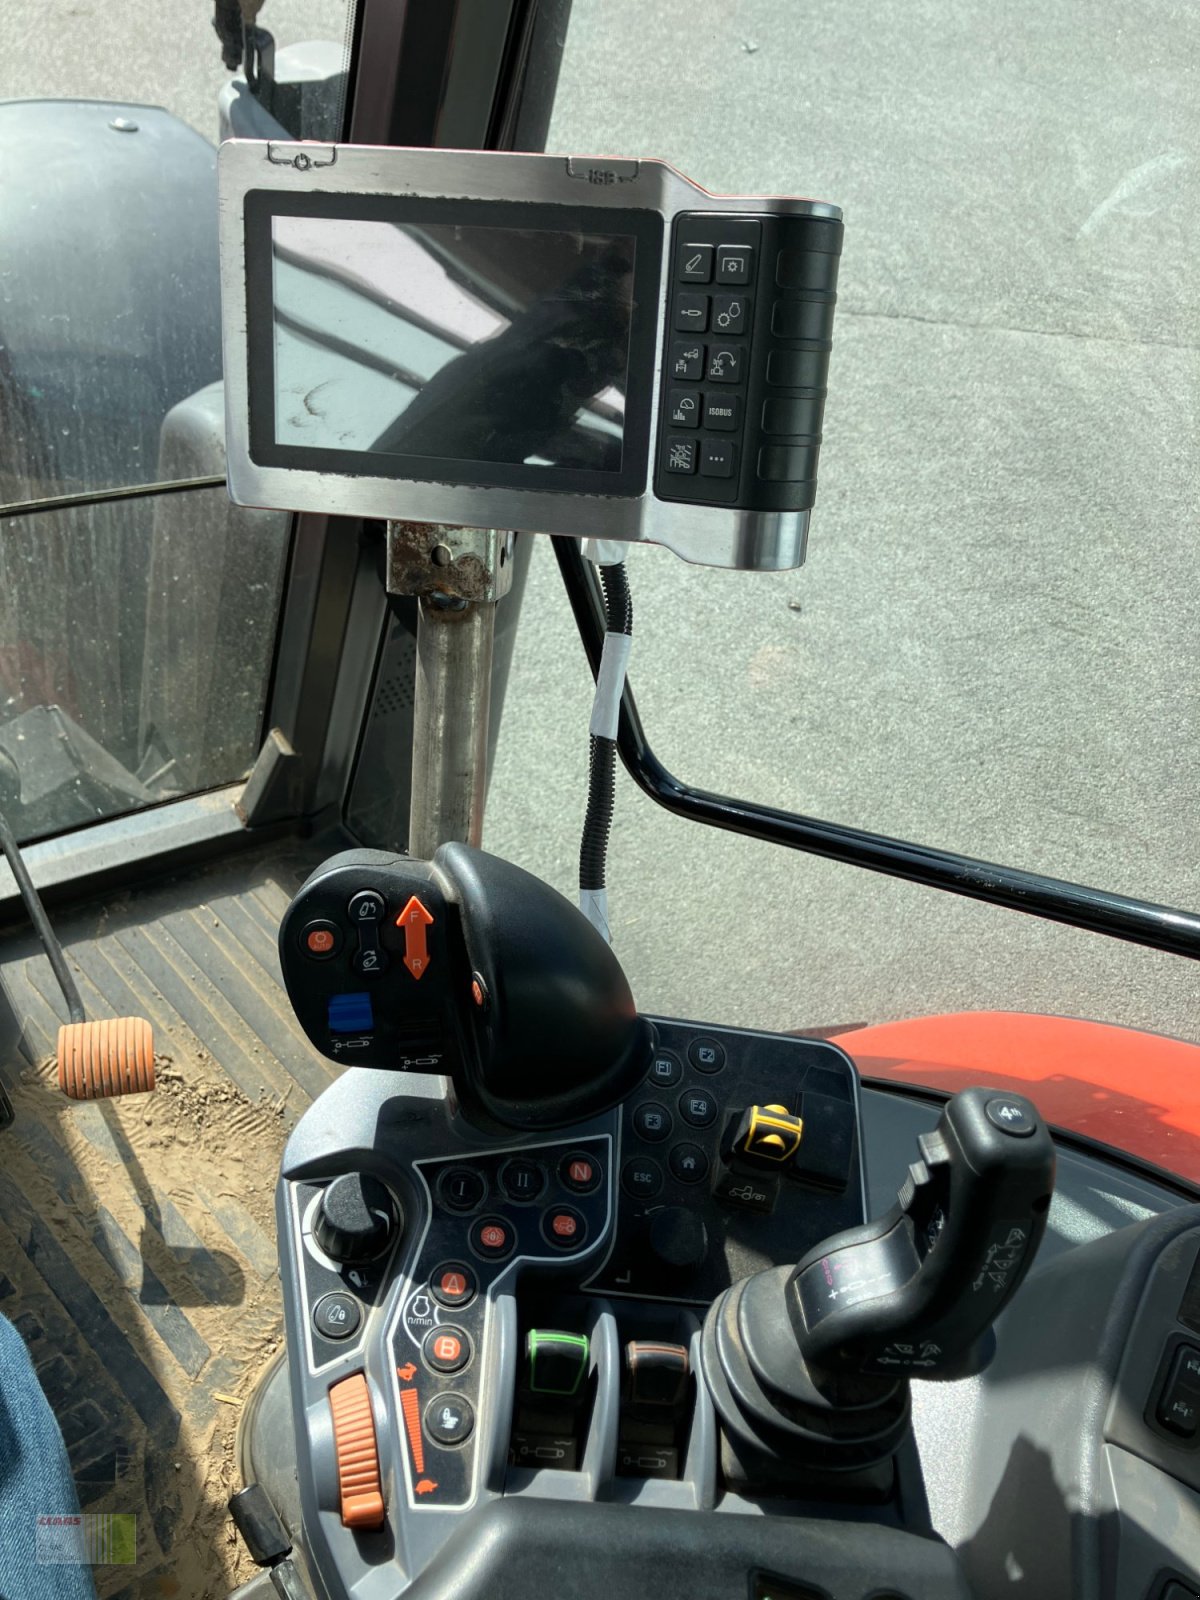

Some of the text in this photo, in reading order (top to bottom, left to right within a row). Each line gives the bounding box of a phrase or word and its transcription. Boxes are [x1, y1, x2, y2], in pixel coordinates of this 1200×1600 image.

[708, 407, 732, 417] ISOBUS
[410, 911, 419, 922] F
[412, 960, 422, 970] R
[701, 1050, 713, 1060] F2
[657, 1063, 669, 1074] F1
[692, 1102, 705, 1113] F4
[1000, 1106, 1022, 1120] 4th
[574, 1163, 587, 1180] N
[633, 1172, 652, 1183] ESC
[448, 1275, 460, 1292] A
[407, 1315, 433, 1327] n/min
[440, 1338, 454, 1355] B
